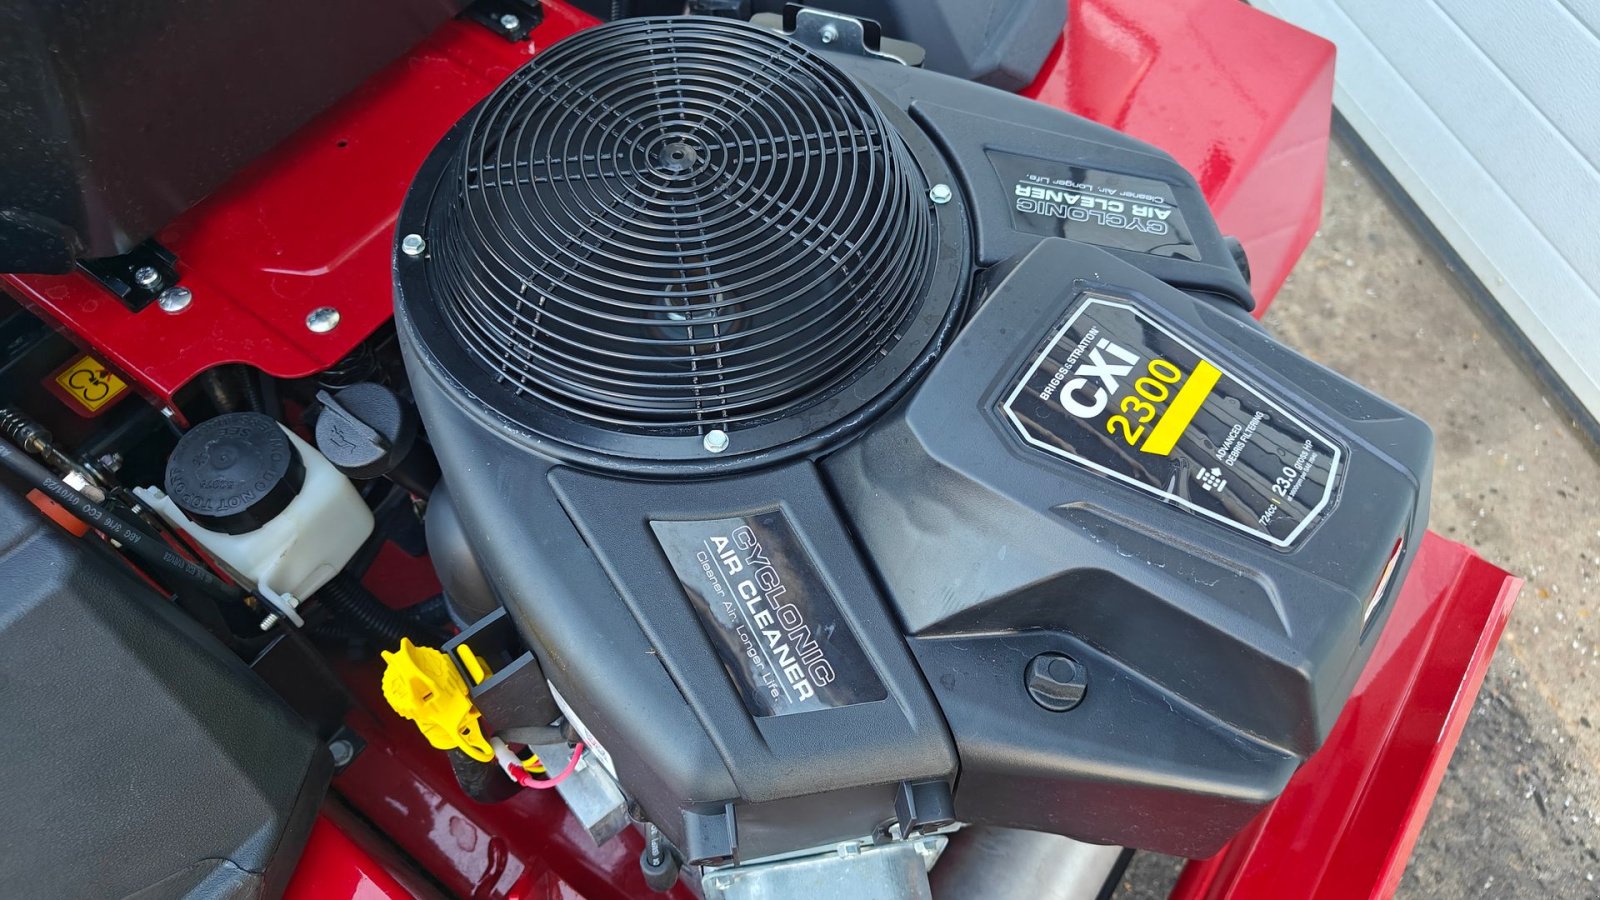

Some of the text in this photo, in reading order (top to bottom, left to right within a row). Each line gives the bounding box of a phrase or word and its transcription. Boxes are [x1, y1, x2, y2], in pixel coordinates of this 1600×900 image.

[1015, 184, 1171, 221] AIR CLEANER
[1052, 178, 1093, 192] Longer
[1119, 190, 1165, 203] Cleaner
[1016, 198, 1168, 235] CYCLONIC
[1060, 337, 1140, 419] CXi
[1106, 358, 1182, 446] 2300
[1215, 424, 1242, 461] ADVANCED
[1225, 411, 1264, 467] DEBRIS FILTERING
[254, 470, 281, 492] DO
[1258, 439, 1313, 526] 724cc 23.0 gross HP
[82, 504, 103, 520] ECO
[182, 493, 213, 511] TOP
[217, 490, 257, 511] NOT
[709, 535, 815, 703] AIR CLEANER
[731, 525, 836, 688] CYCLONIC
[696, 551, 726, 598] Cleaner
[735, 625, 765, 672] Longer
[762, 670, 781, 702] Life.
